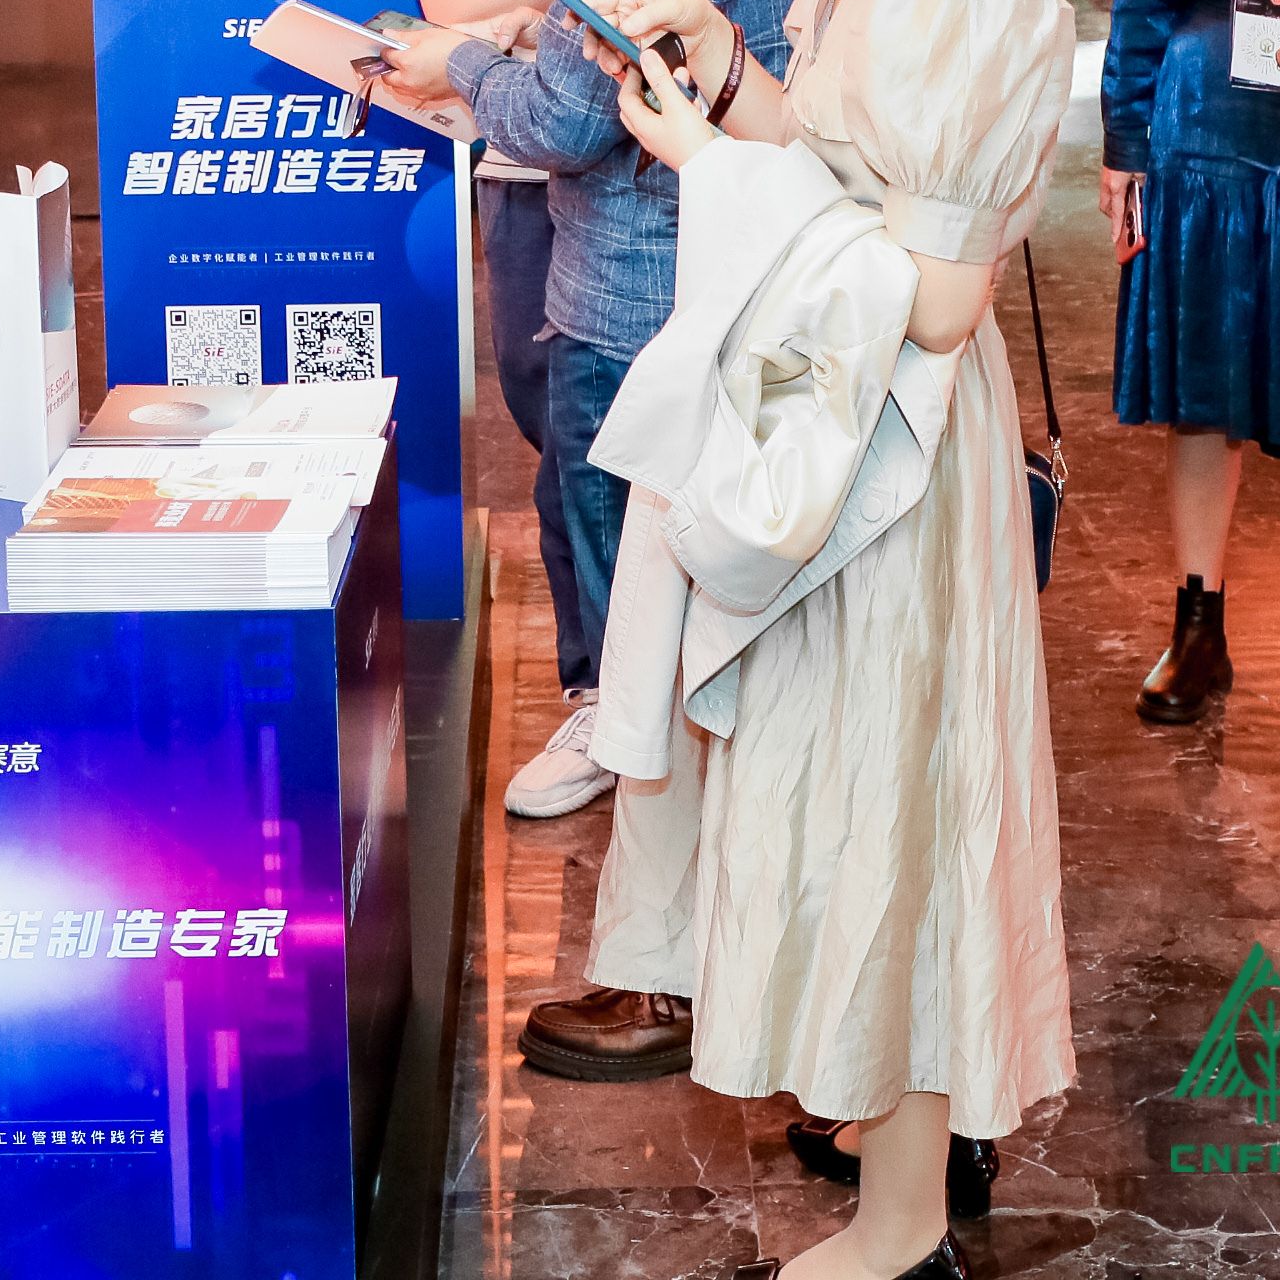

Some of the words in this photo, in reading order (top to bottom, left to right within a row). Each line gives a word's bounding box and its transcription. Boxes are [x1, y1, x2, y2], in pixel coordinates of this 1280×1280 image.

[170, 95, 371, 140] 家居行业
[123, 149, 426, 195] 智能制造专家
[168, 252, 259, 264] 企业数字化赋能者
[274, 251, 376, 263] 工业管理软件践行者
[204, 346, 225, 357] SiE
[325, 346, 343, 356] SiE
